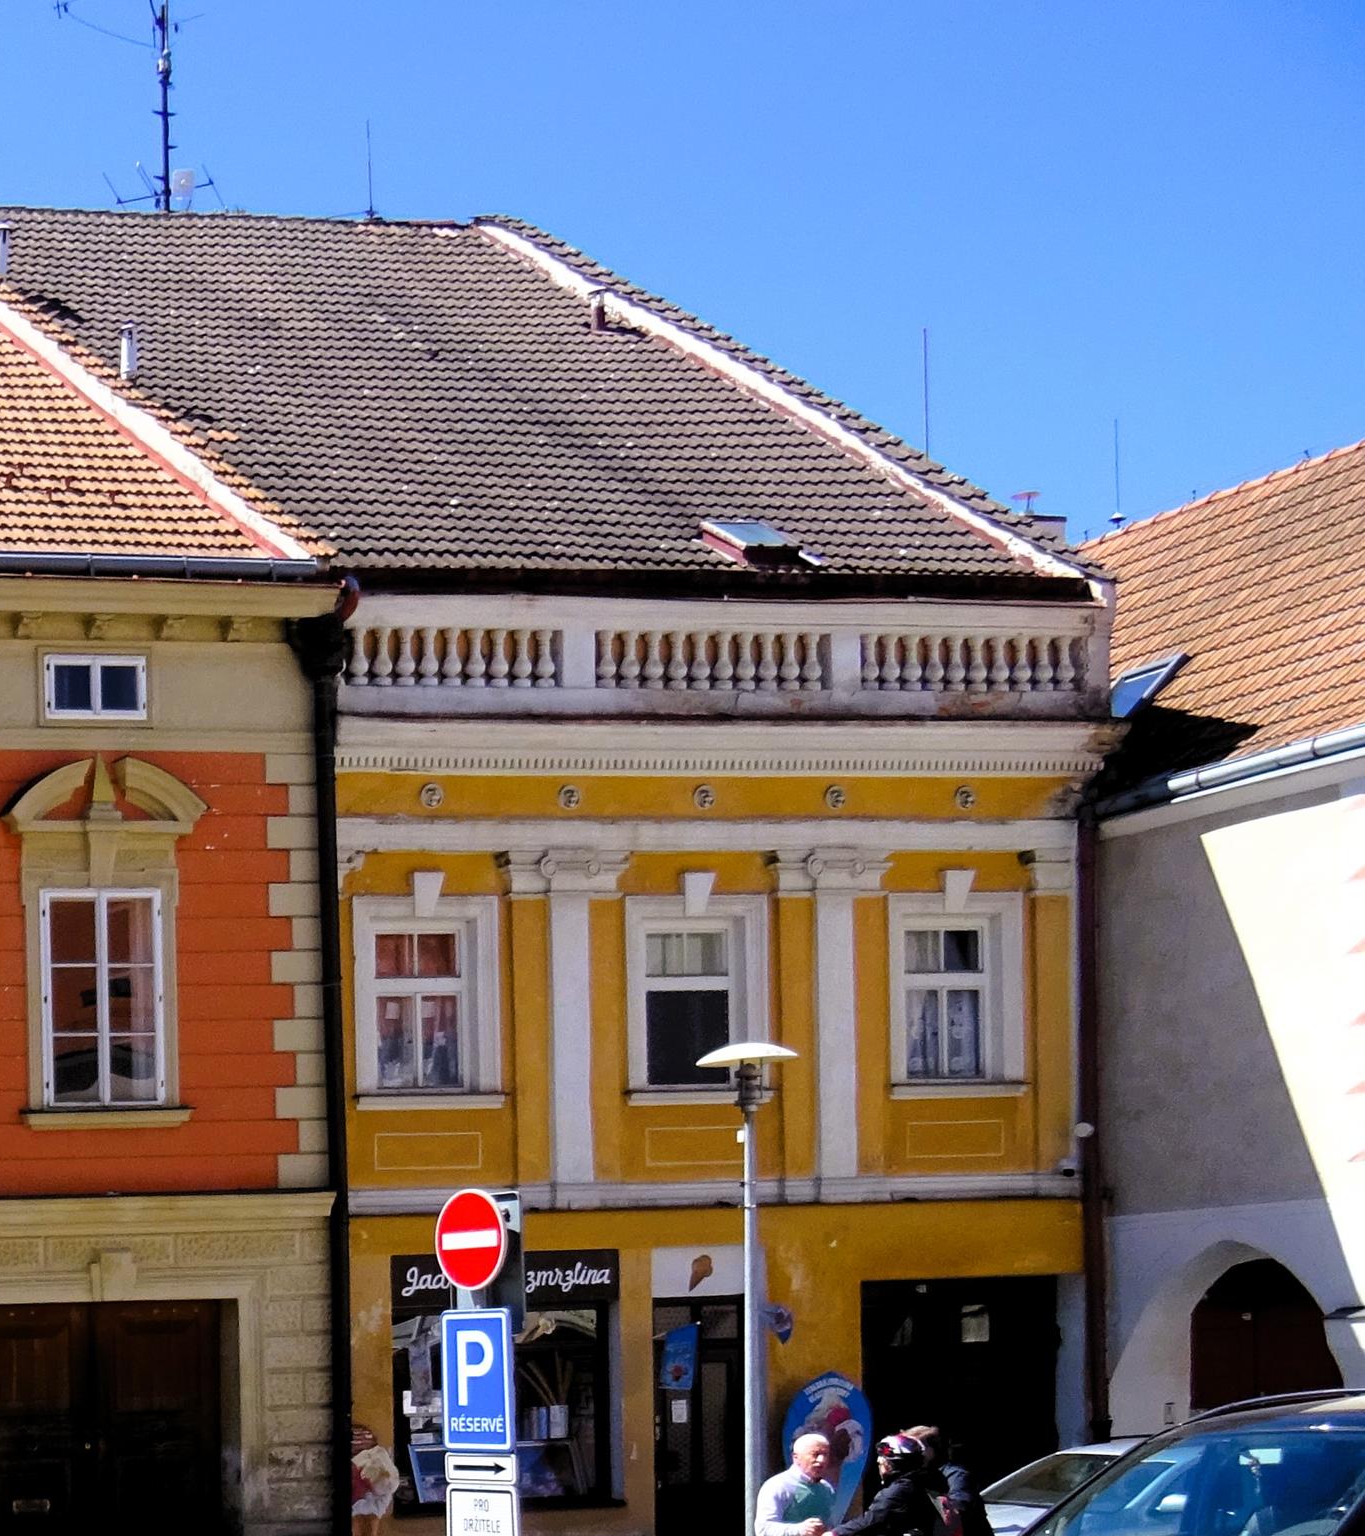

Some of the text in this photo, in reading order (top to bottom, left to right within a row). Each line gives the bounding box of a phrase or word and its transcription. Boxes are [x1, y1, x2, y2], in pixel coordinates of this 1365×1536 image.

[525, 1262, 611, 1292] zmrzlina
[456, 1329, 494, 1406] P
[450, 1414, 504, 1432] RÉSERVÉ
[473, 1498, 489, 1512] PRO
[463, 1515, 500, 1534] DRŽITELE
